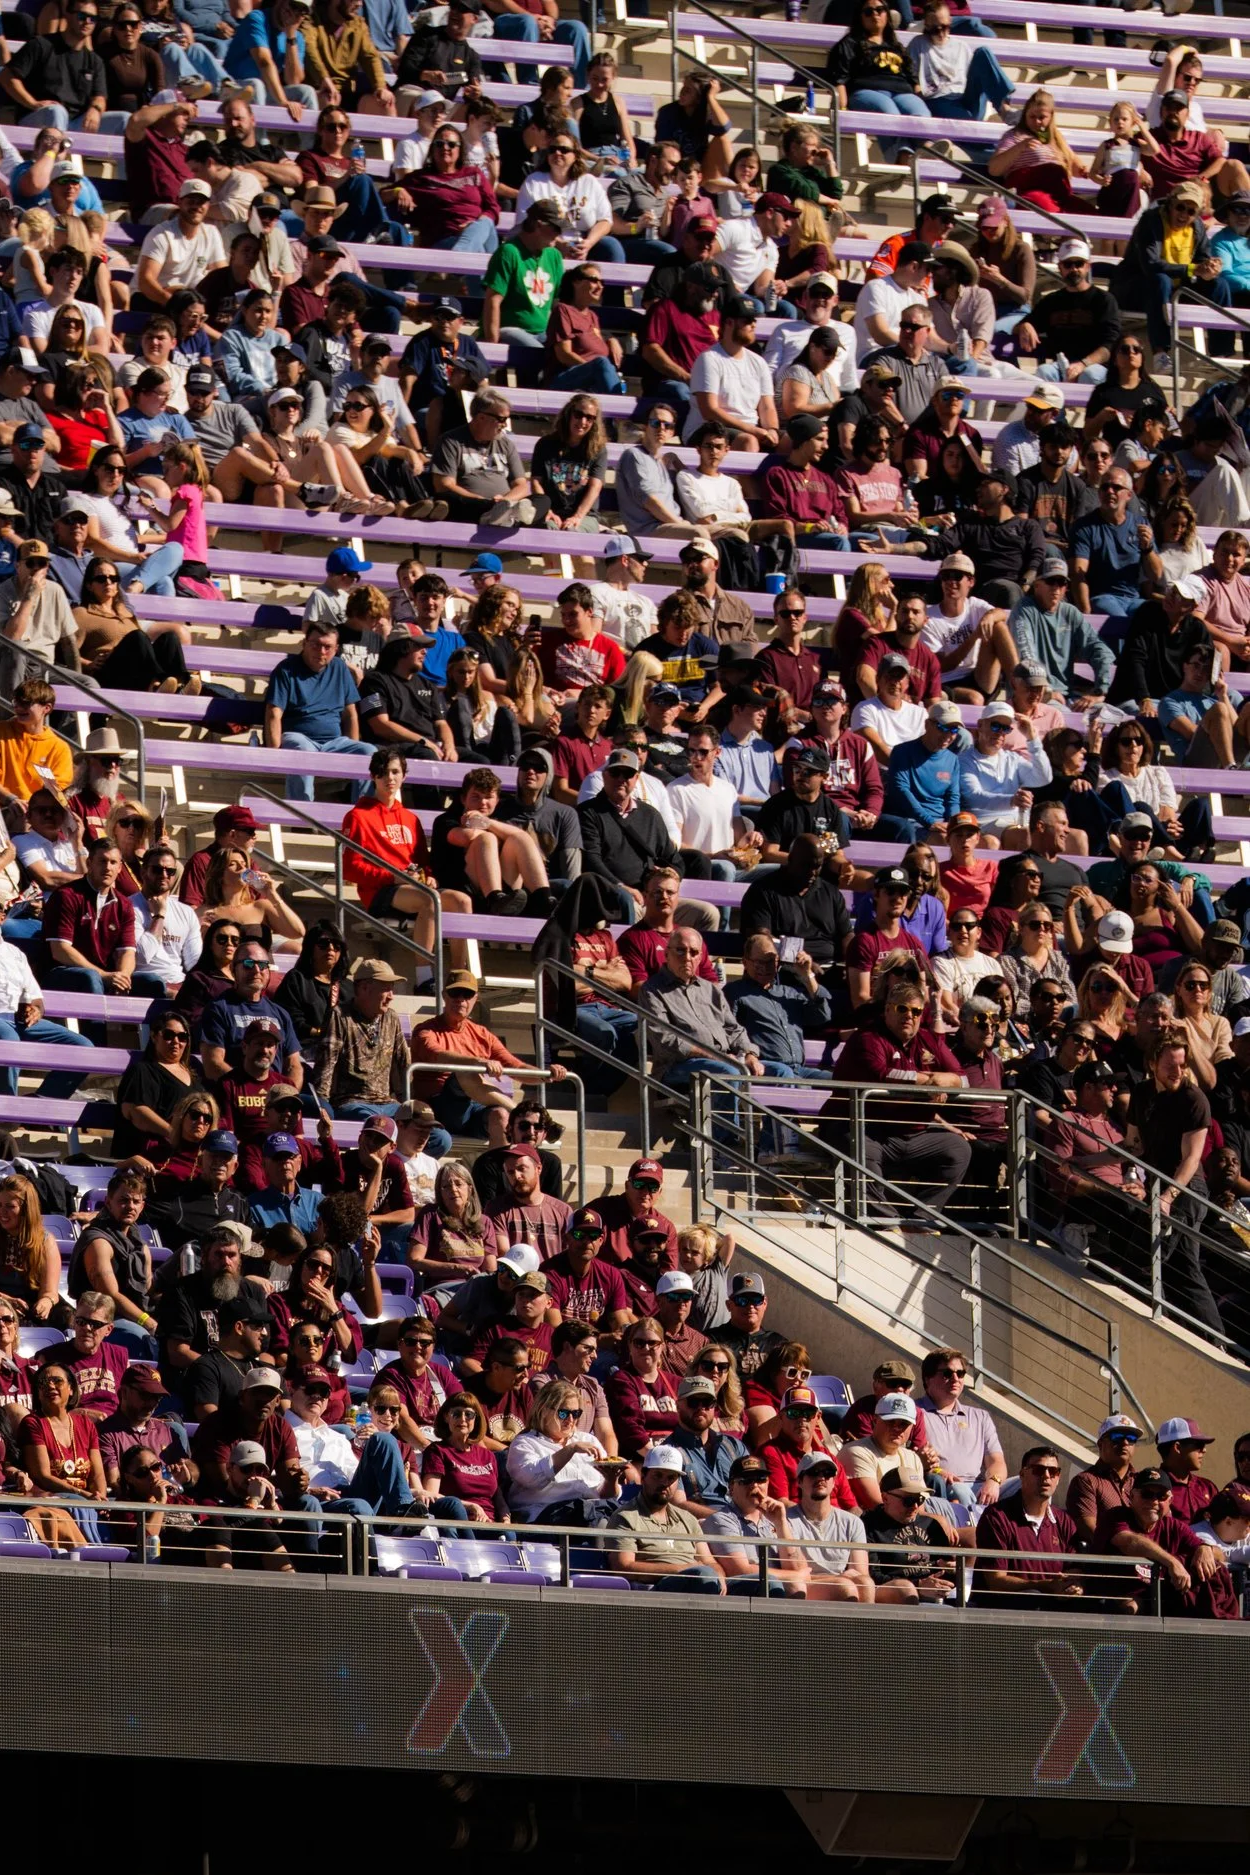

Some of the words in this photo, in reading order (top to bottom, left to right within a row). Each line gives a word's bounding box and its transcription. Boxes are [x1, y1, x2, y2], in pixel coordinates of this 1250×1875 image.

[533, 279, 546, 294] N
[405, 1606, 513, 1758] X
[1033, 1639, 1137, 1788] X
